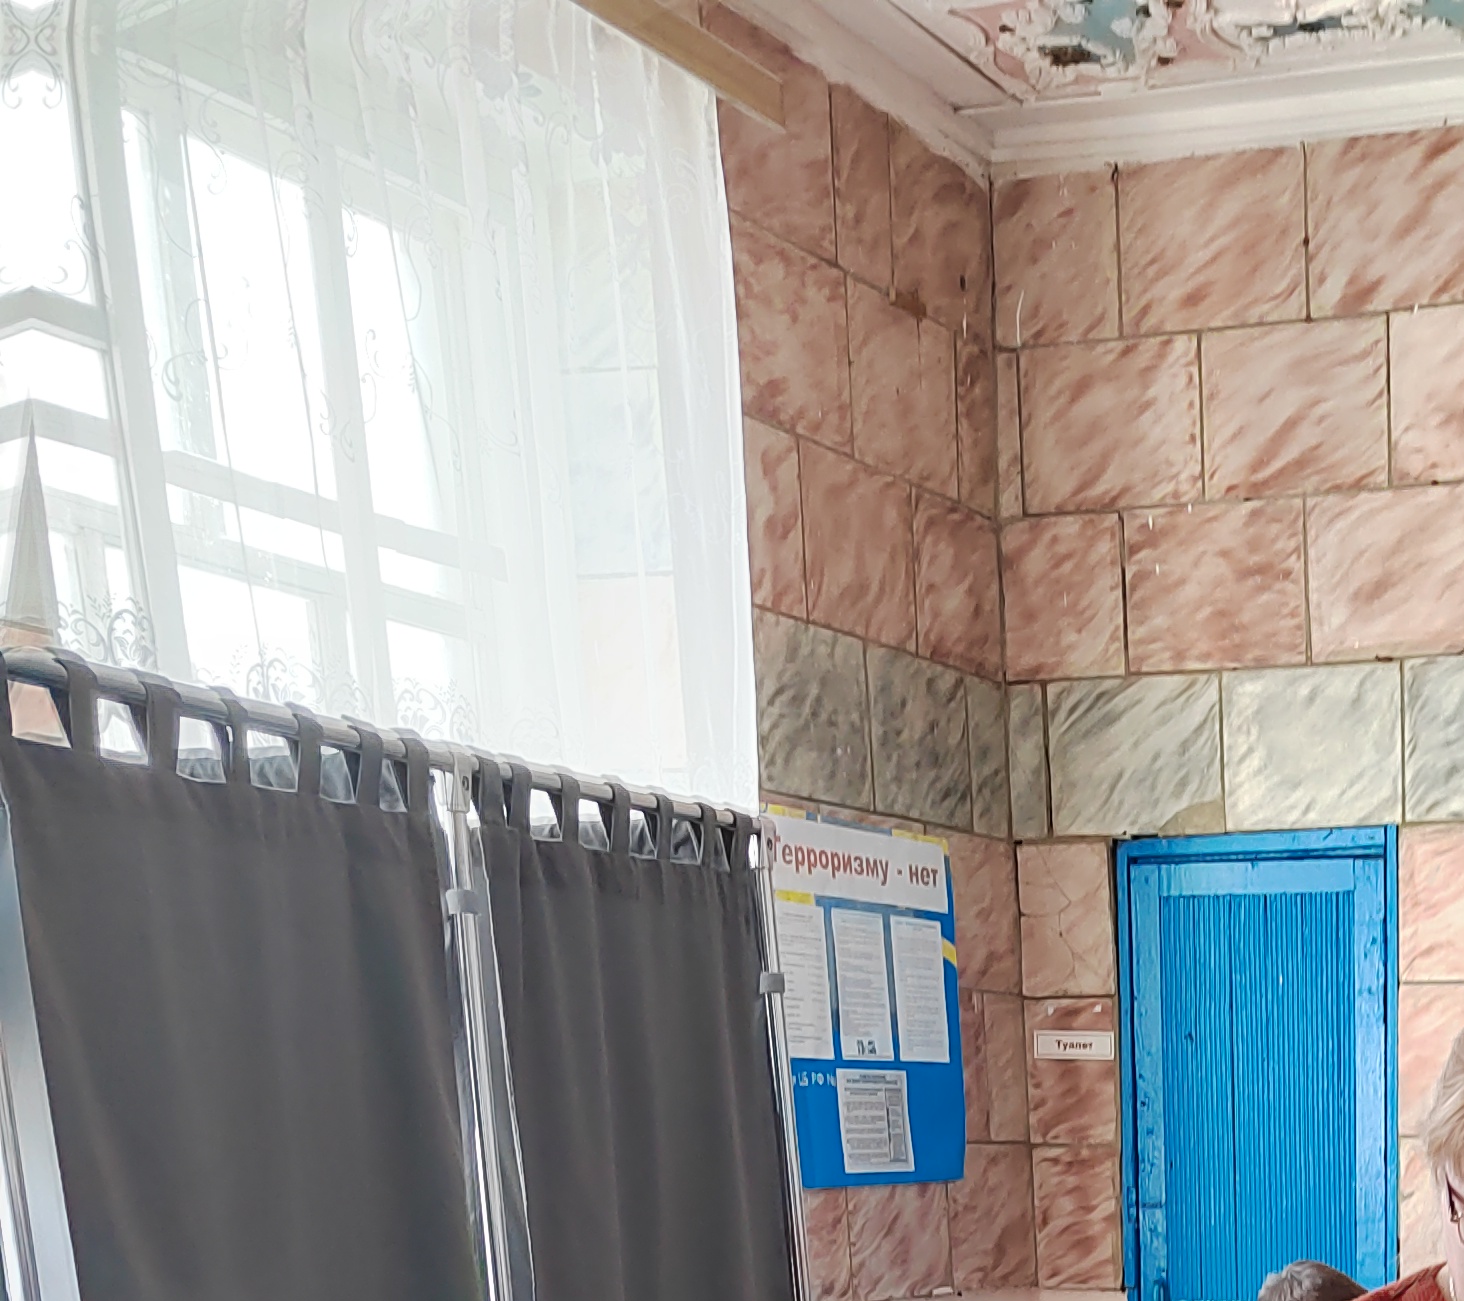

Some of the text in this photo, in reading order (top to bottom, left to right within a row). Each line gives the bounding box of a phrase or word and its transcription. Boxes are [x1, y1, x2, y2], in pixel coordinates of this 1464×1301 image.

[773, 834, 889, 887] Терроризму
[908, 864, 939, 888] нет
[1055, 1039, 1093, 1052] Туалет
